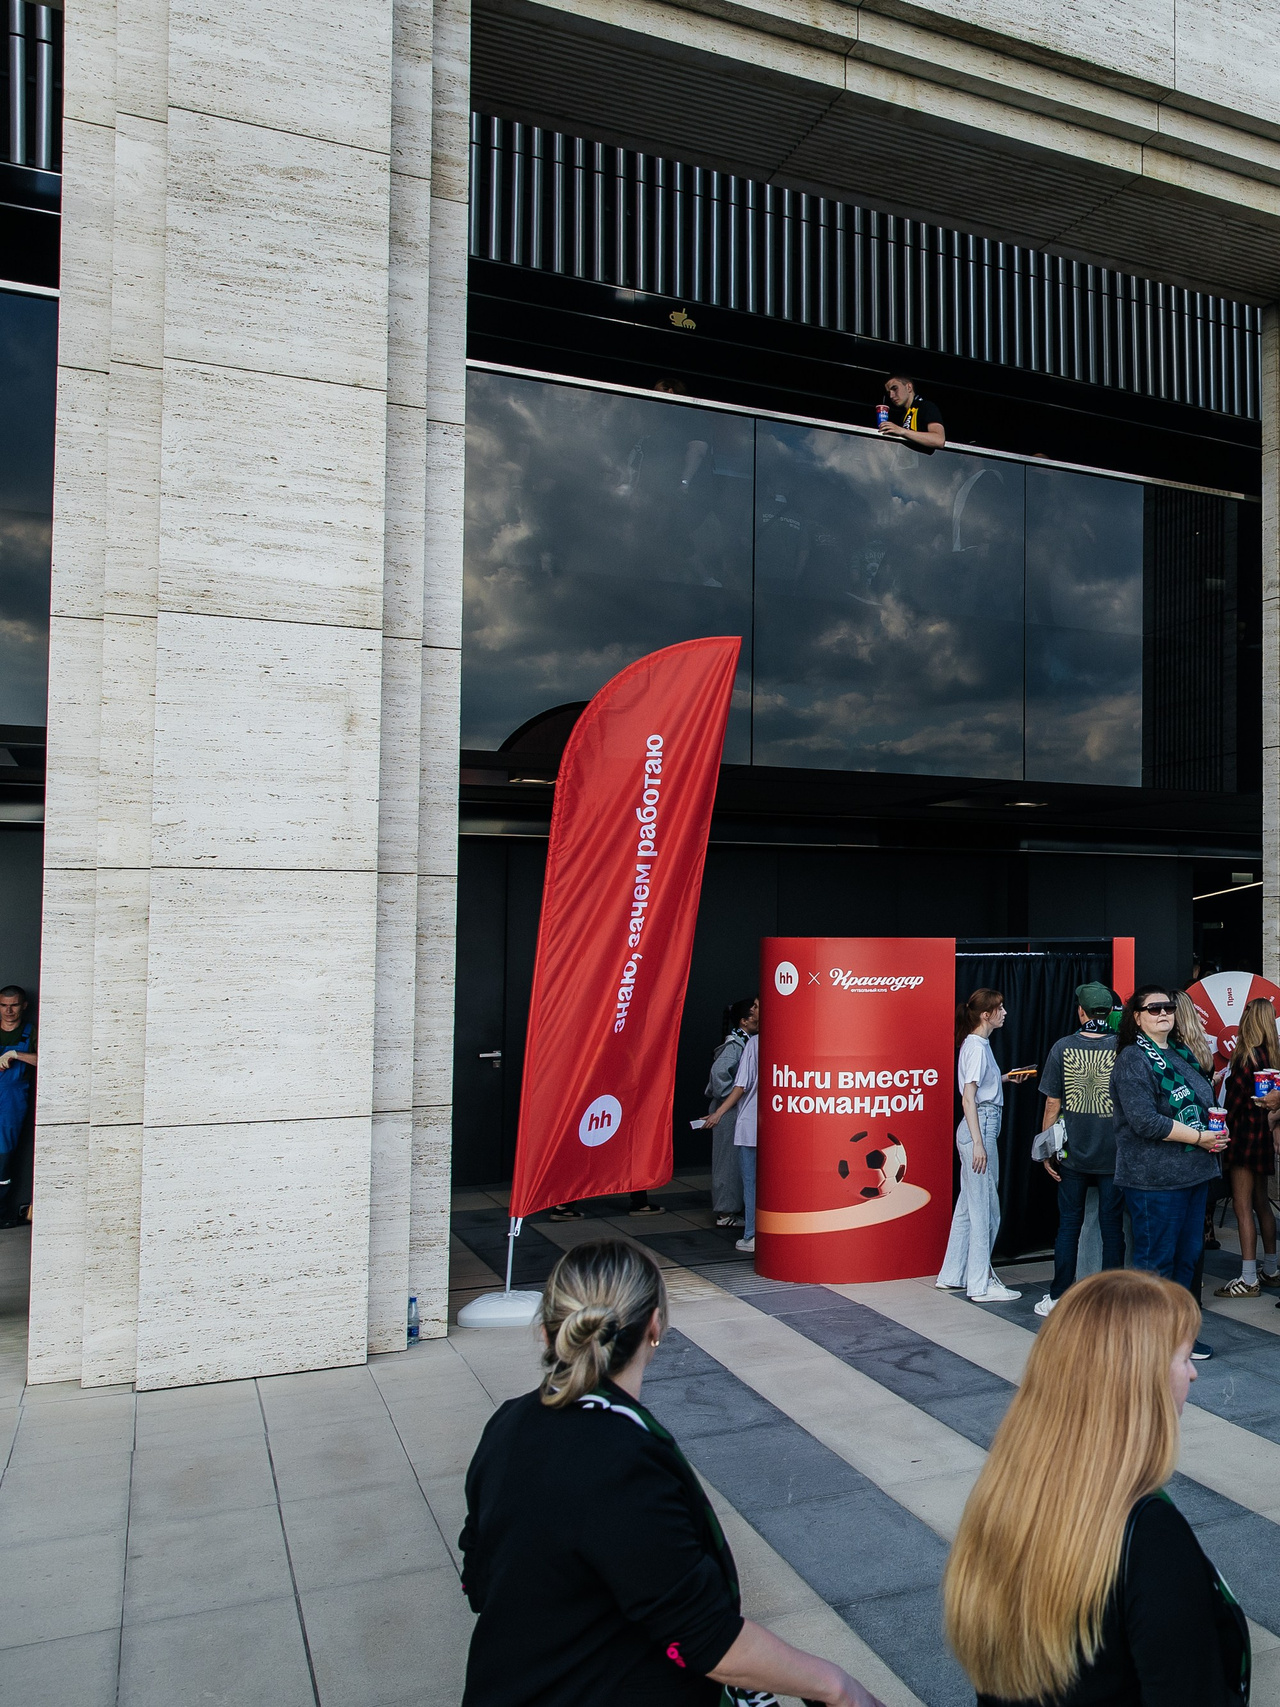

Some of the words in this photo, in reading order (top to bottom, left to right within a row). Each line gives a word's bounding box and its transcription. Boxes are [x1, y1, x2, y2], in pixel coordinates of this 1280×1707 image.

[636, 733, 665, 857] работаю
[628, 863, 652, 948] зачем
[780, 972, 793, 984] hh
[829, 967, 925, 992] Краснодар
[614, 952, 643, 1033] знаю,
[1226, 987, 1234, 1007] Приз
[772, 1063, 831, 1089] hh.ru
[838, 1068, 939, 1089] вместе
[772, 1095, 783, 1113] с
[787, 1088, 924, 1118] командой
[1173, 1088, 1191, 1102] 2008
[587, 1110, 612, 1132] hh
